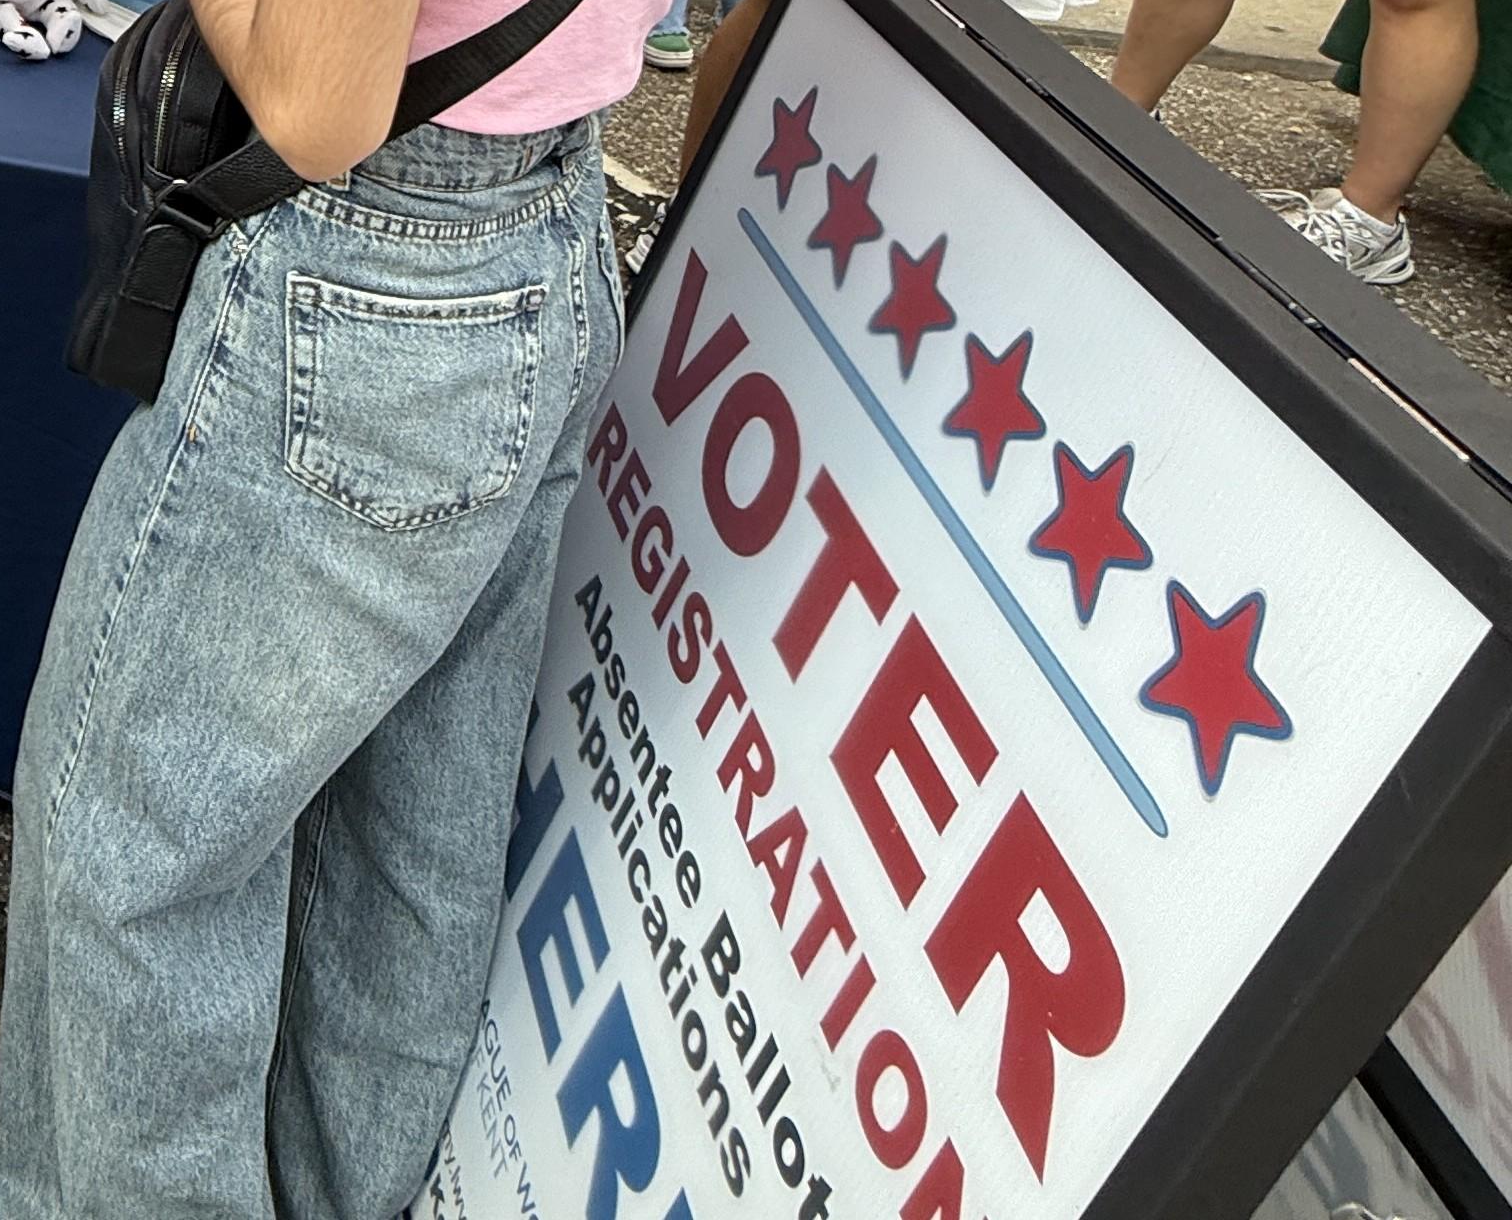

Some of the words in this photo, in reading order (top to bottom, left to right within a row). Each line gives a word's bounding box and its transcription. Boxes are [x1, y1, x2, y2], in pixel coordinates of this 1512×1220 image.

[574, 574, 701, 909] Absentee
[651, 247, 1126, 1187] VOTER
[567, 672, 751, 1199] Applications
[477, 1071, 509, 1178] KENT
[504, 1114, 522, 1162] OF
